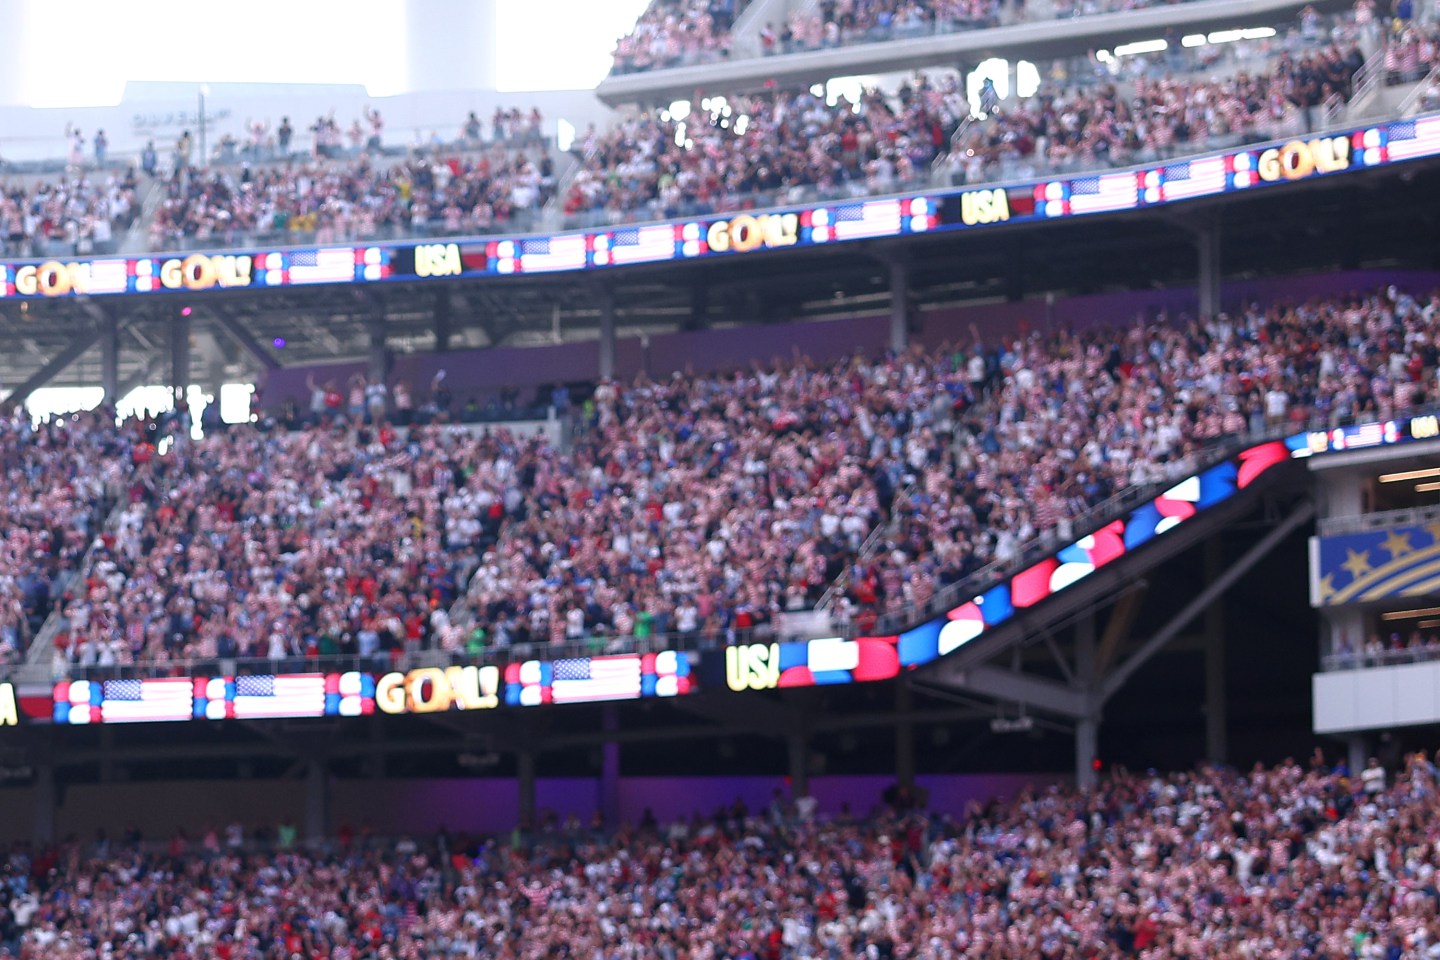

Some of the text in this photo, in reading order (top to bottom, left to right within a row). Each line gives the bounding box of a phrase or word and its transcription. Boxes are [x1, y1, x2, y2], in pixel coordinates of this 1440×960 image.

[1257, 136, 1350, 181] GOAL!
[961, 189, 1009, 226] USA
[707, 213, 797, 252] GOAL!
[160, 253, 251, 291] GOAL!
[414, 244, 462, 276] USA
[376, 666, 499, 714] GOAL!
